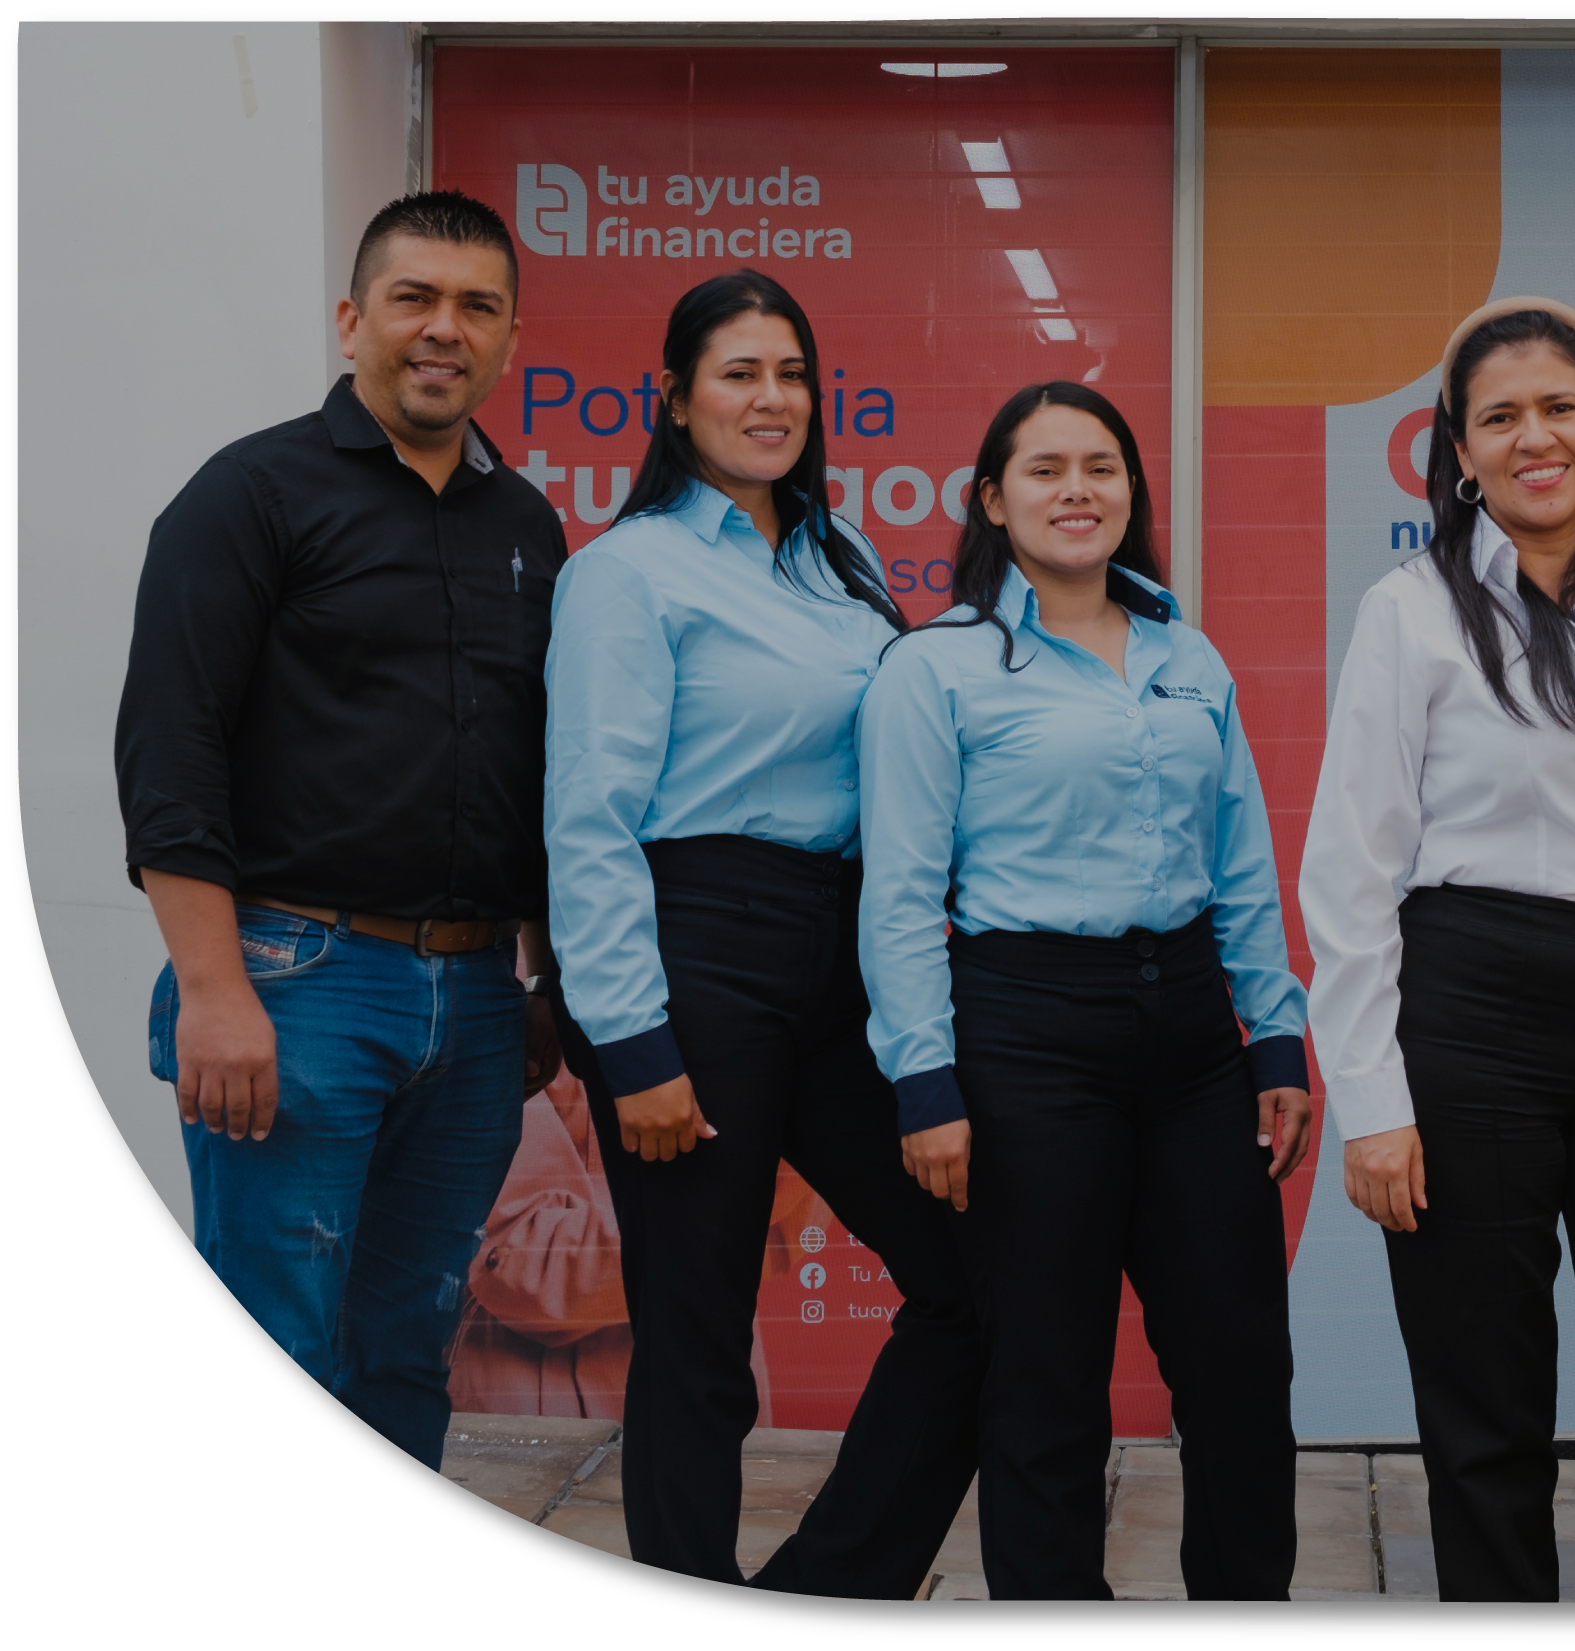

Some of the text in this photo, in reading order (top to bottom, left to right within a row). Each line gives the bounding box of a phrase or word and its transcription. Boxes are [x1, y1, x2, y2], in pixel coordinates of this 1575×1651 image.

[598, 165, 821, 216] tu ayuda
[596, 216, 853, 259] financiera
[523, 367, 893, 437] Potia
[848, 1266, 871, 1282] Tu
